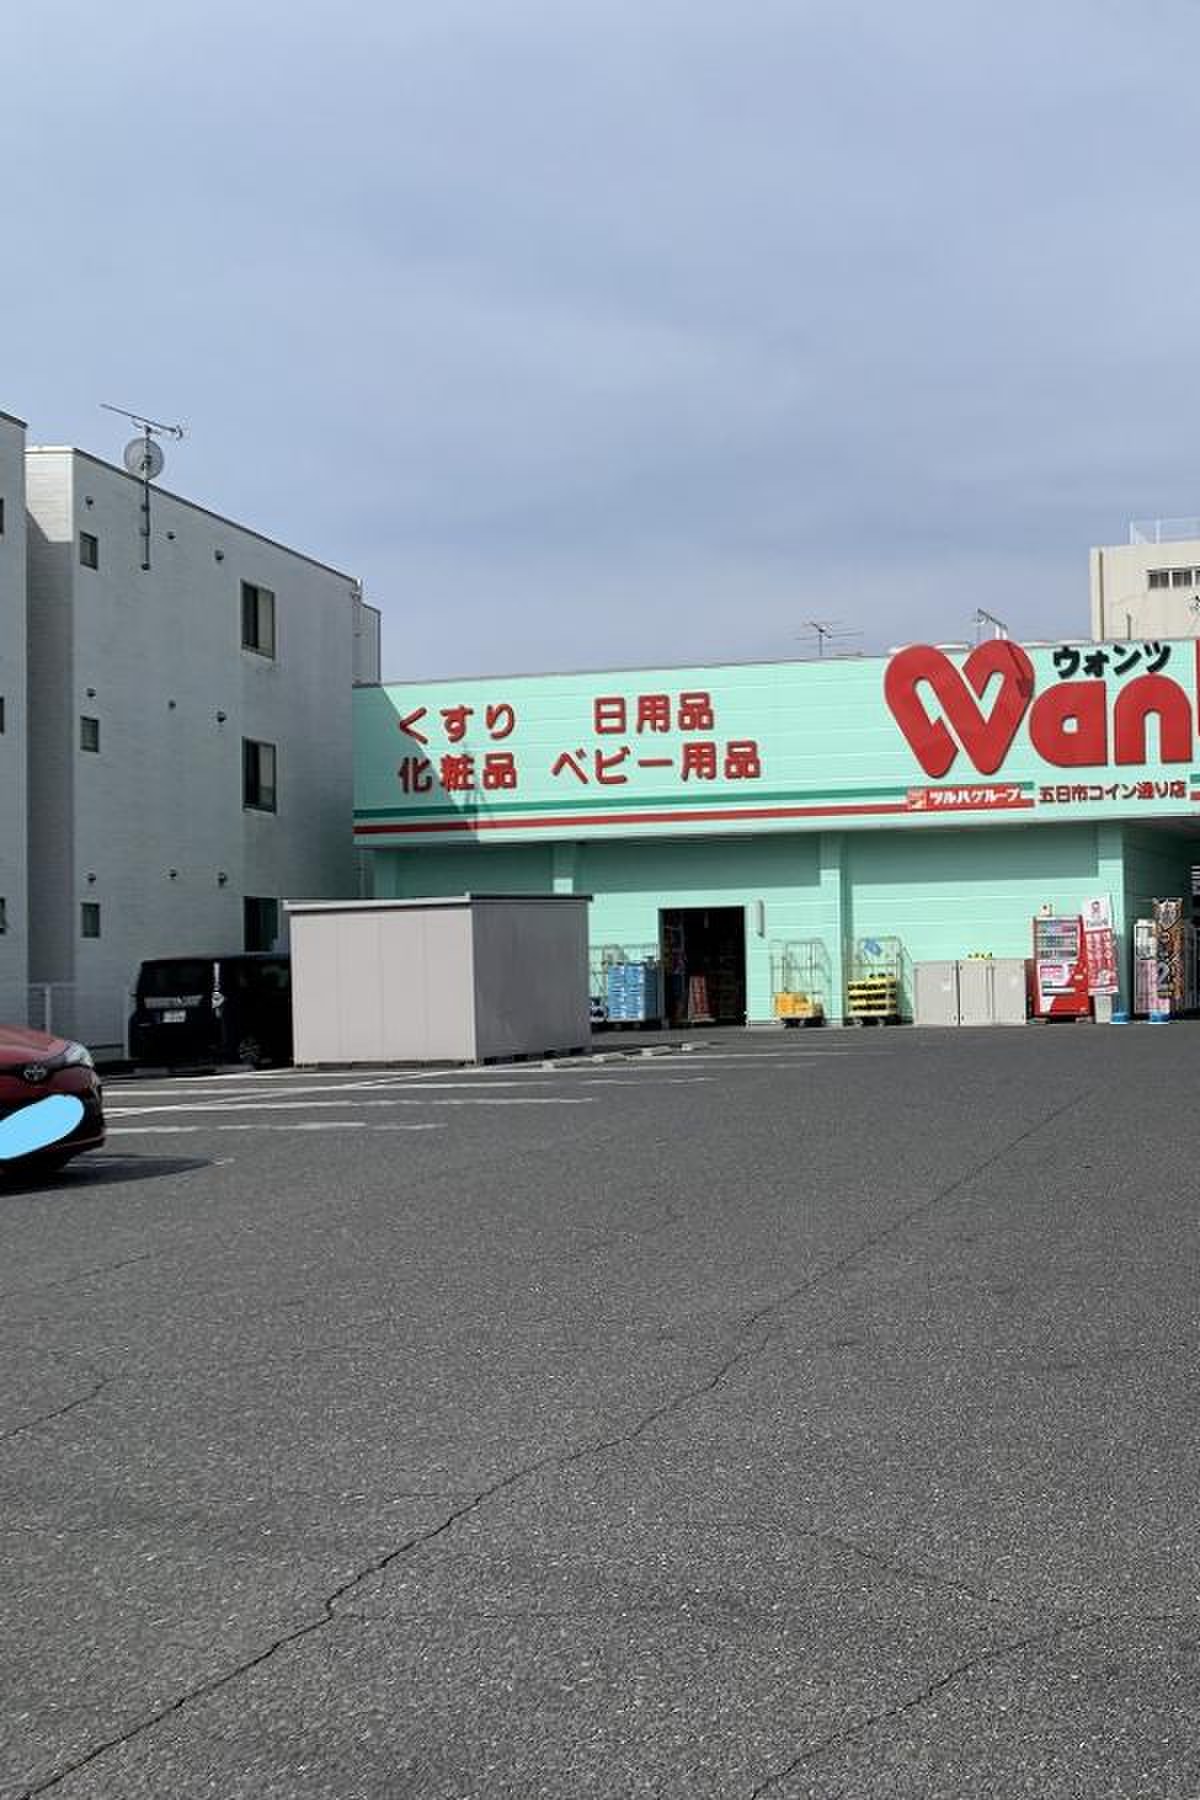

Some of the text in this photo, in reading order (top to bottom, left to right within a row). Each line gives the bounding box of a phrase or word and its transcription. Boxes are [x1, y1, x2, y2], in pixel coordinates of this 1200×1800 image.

[1053, 642, 1171, 679] ウォンツ
[398, 692, 714, 744] くすり 日用品
[398, 741, 761, 794] 化粧品 ベビー用品
[1039, 780, 1187, 804] 五日市コイン通り店
